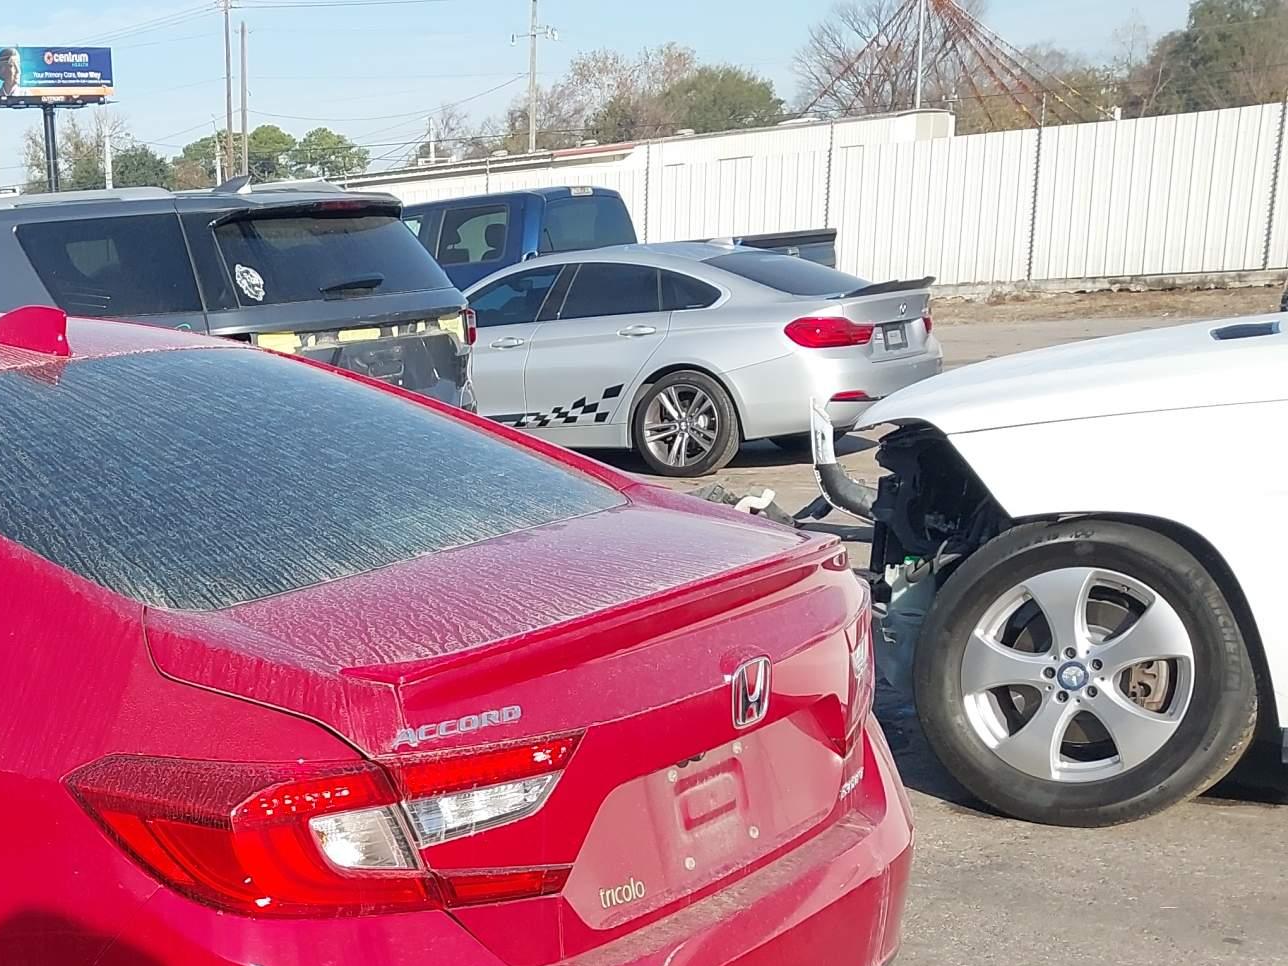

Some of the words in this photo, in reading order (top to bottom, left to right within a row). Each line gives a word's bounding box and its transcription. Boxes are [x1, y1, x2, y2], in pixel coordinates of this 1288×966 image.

[53, 51, 89, 63] centrum
[45, 71, 63, 79] Primary
[63, 71, 77, 79] Care,
[89, 71, 101, 79] Way
[392, 705, 522, 750] ACCORD
[599, 877, 645, 908] tricolo
